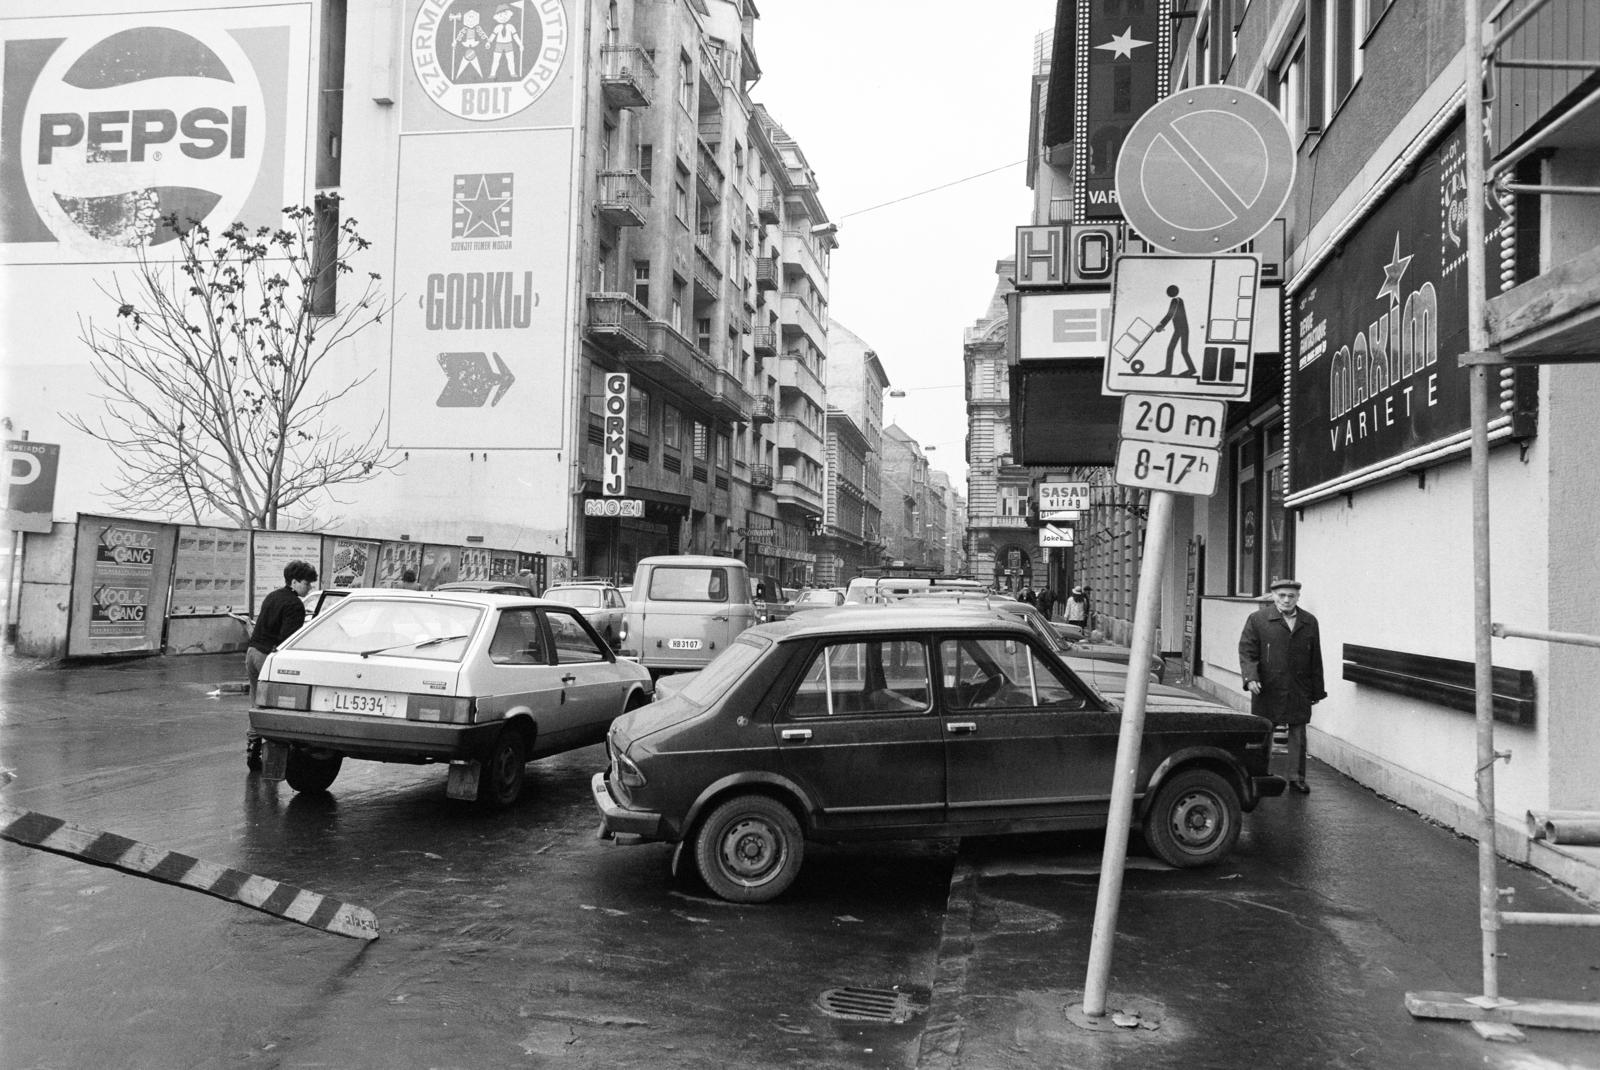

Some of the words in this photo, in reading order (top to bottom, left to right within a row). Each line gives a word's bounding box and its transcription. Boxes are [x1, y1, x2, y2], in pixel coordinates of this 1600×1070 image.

[416, 0, 450, 98] EZERME
[461, 86, 512, 116] BOLT
[38, 106, 247, 165] PEPSI
[1089, 190, 1118, 203] VAR
[1136, 401, 1175, 433] 20
[1185, 415, 1216, 438] m
[1330, 373, 1437, 451] VARIETE
[606, 375, 625, 494] GORKIJ
[1041, 486, 1088, 498] SASAD
[585, 500, 642, 516] MOZI
[106, 530, 139, 547] KOOL
[114, 547, 151, 564] GANG
[100, 588, 133, 605] KOOL
[108, 605, 144, 621] GANG
